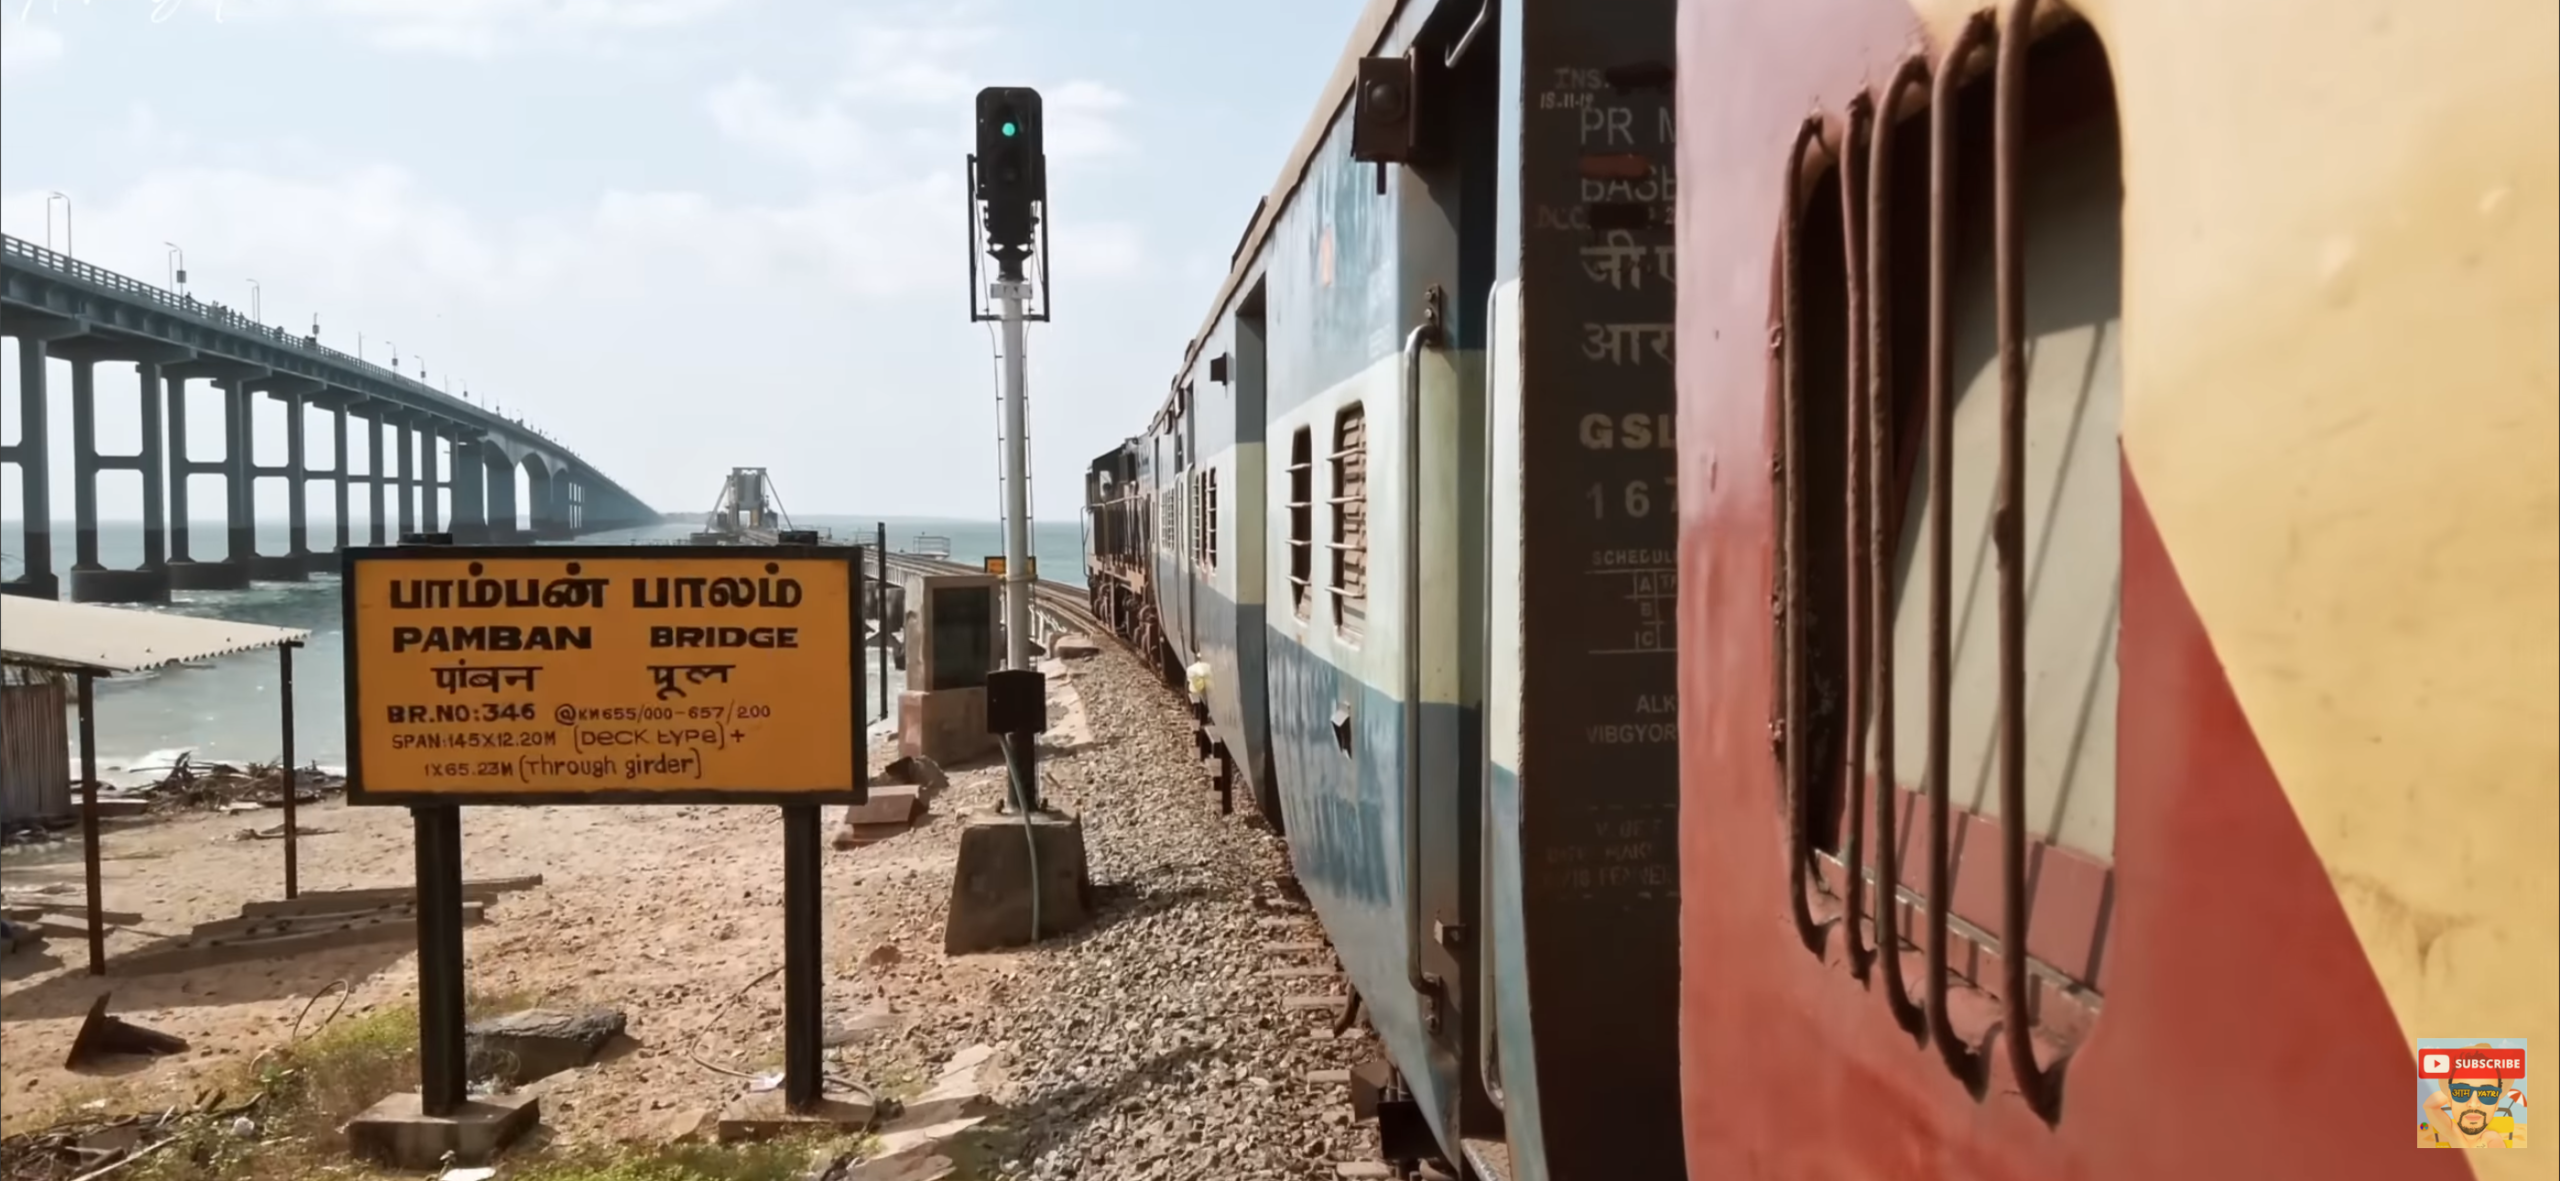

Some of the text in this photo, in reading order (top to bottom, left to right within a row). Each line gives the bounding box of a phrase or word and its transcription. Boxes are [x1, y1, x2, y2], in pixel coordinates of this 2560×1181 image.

[1580, 106, 1635, 146] PR
[1579, 412, 1676, 450] GSL
[1591, 549, 1677, 566] SCHEDUL
[389, 561, 802, 609] பாம்பன் பாலம்
[393, 625, 798, 653] PAMBAN BRIDGE
[430, 658, 543, 695] पांबन
[1585, 723, 1677, 744] VIBGYOR
